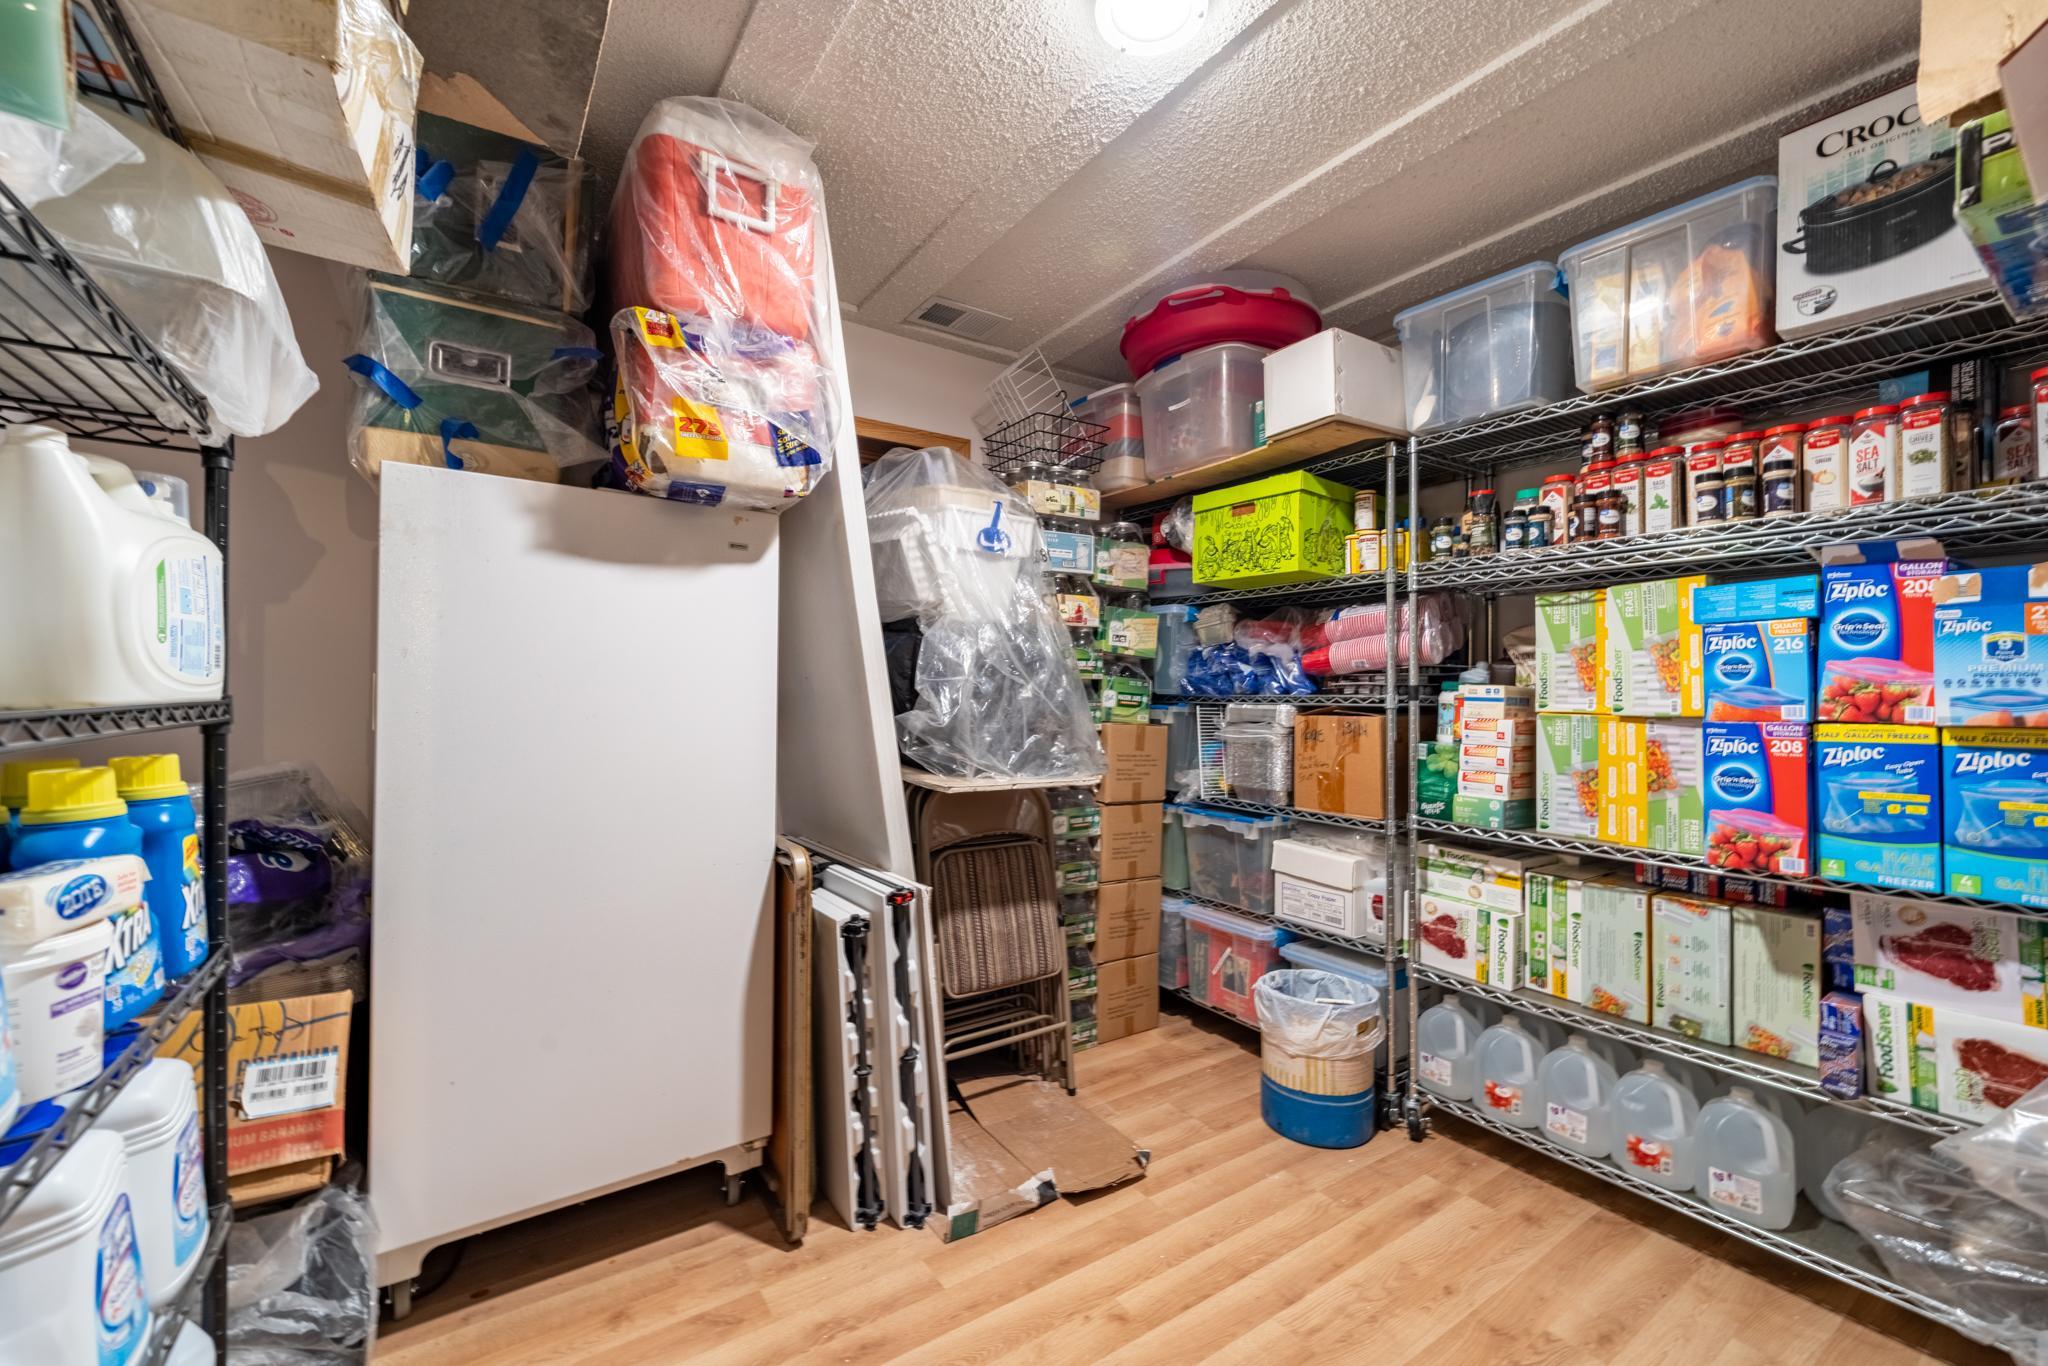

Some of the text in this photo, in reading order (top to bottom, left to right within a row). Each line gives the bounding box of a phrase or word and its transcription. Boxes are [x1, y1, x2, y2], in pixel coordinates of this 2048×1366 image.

[1848, 146, 1867, 158] THE
[679, 417, 722, 436] 275
[1856, 445, 1879, 463] SEA
[1856, 459, 1879, 474] SALT
[1899, 562, 1944, 571] GALLON
[1830, 582, 1890, 603] Ziploc
[1625, 591, 1634, 618] FRAIS
[1772, 622, 1803, 630] QUART
[1942, 619, 1992, 636] Ziploc
[1708, 635, 1758, 654] Ziploc
[1773, 637, 1804, 651] 216
[1540, 652, 1549, 700] FoodSaver
[1613, 649, 1623, 702] FoodSaver
[1968, 663, 2045, 672] PREMIUM
[1766, 724, 1803, 732] GALLON
[1710, 738, 1760, 757] Ziploc
[1770, 740, 1803, 753] 208
[1982, 736, 2031, 744] GALLON
[1823, 745, 1885, 768] Ziploc
[1956, 751, 2031, 774] Ziploc
[1540, 771, 1549, 820] FoodSaver
[1882, 850, 1935, 866] HALF
[1855, 860, 1935, 880] GALLON
[1878, 875, 1935, 889] FREEZER
[103, 901, 152, 975] XTRA
[1571, 921, 1582, 969] FoodSaver
[1497, 928, 1508, 985] FoodSaver
[1802, 969, 1815, 1021] FoodSaver
[1875, 1002, 1893, 1080] FoodSaver
[259, 1121, 323, 1142] BANANAS
